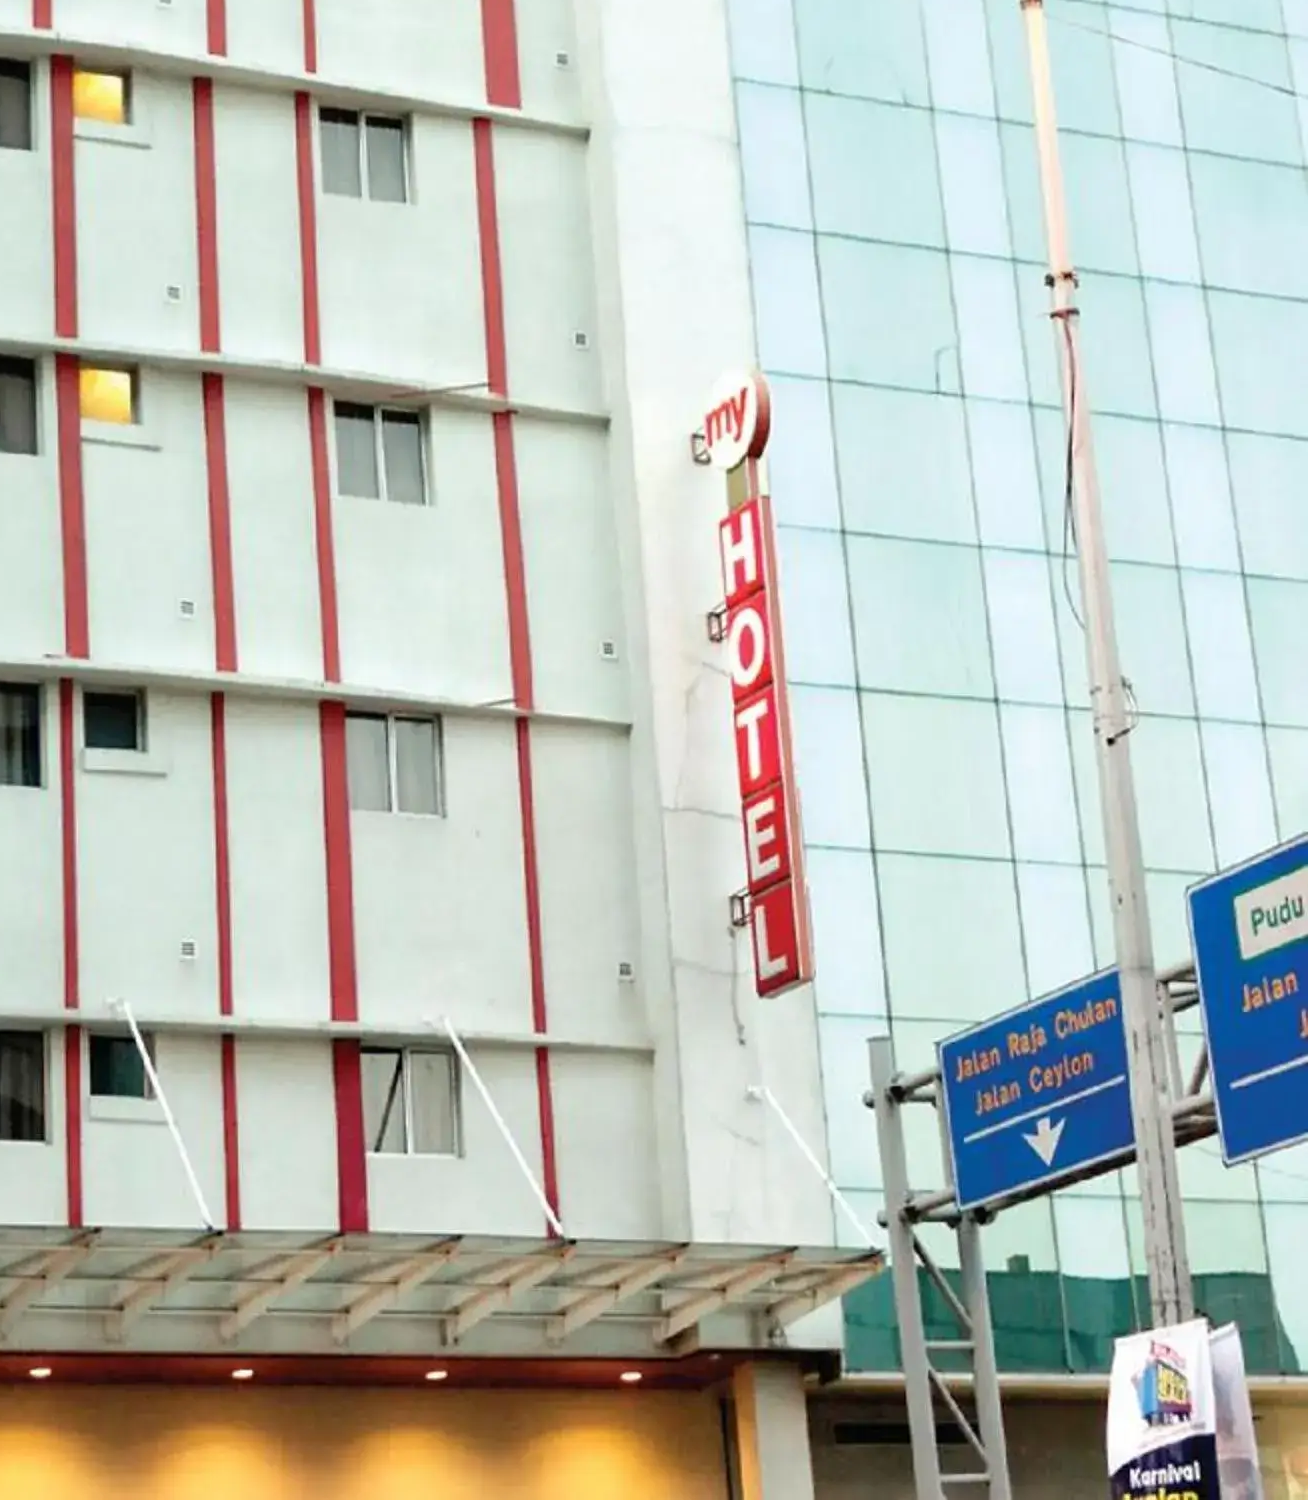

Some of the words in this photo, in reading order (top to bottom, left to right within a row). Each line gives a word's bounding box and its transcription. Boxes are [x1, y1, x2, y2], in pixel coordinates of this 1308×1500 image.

[704, 386, 748, 449] my
[720, 508, 788, 982] HOTEL
[1250, 895, 1304, 937] Pudu
[1243, 970, 1298, 1013] Jalan
[955, 1046, 1001, 1083] Jalan
[1007, 1023, 1048, 1060] Raja
[1055, 997, 1117, 1040] Chulan
[975, 1080, 1021, 1116] Jalan
[1029, 1051, 1094, 1093] Ceylon
[1129, 1460, 1201, 1490] Karnival
